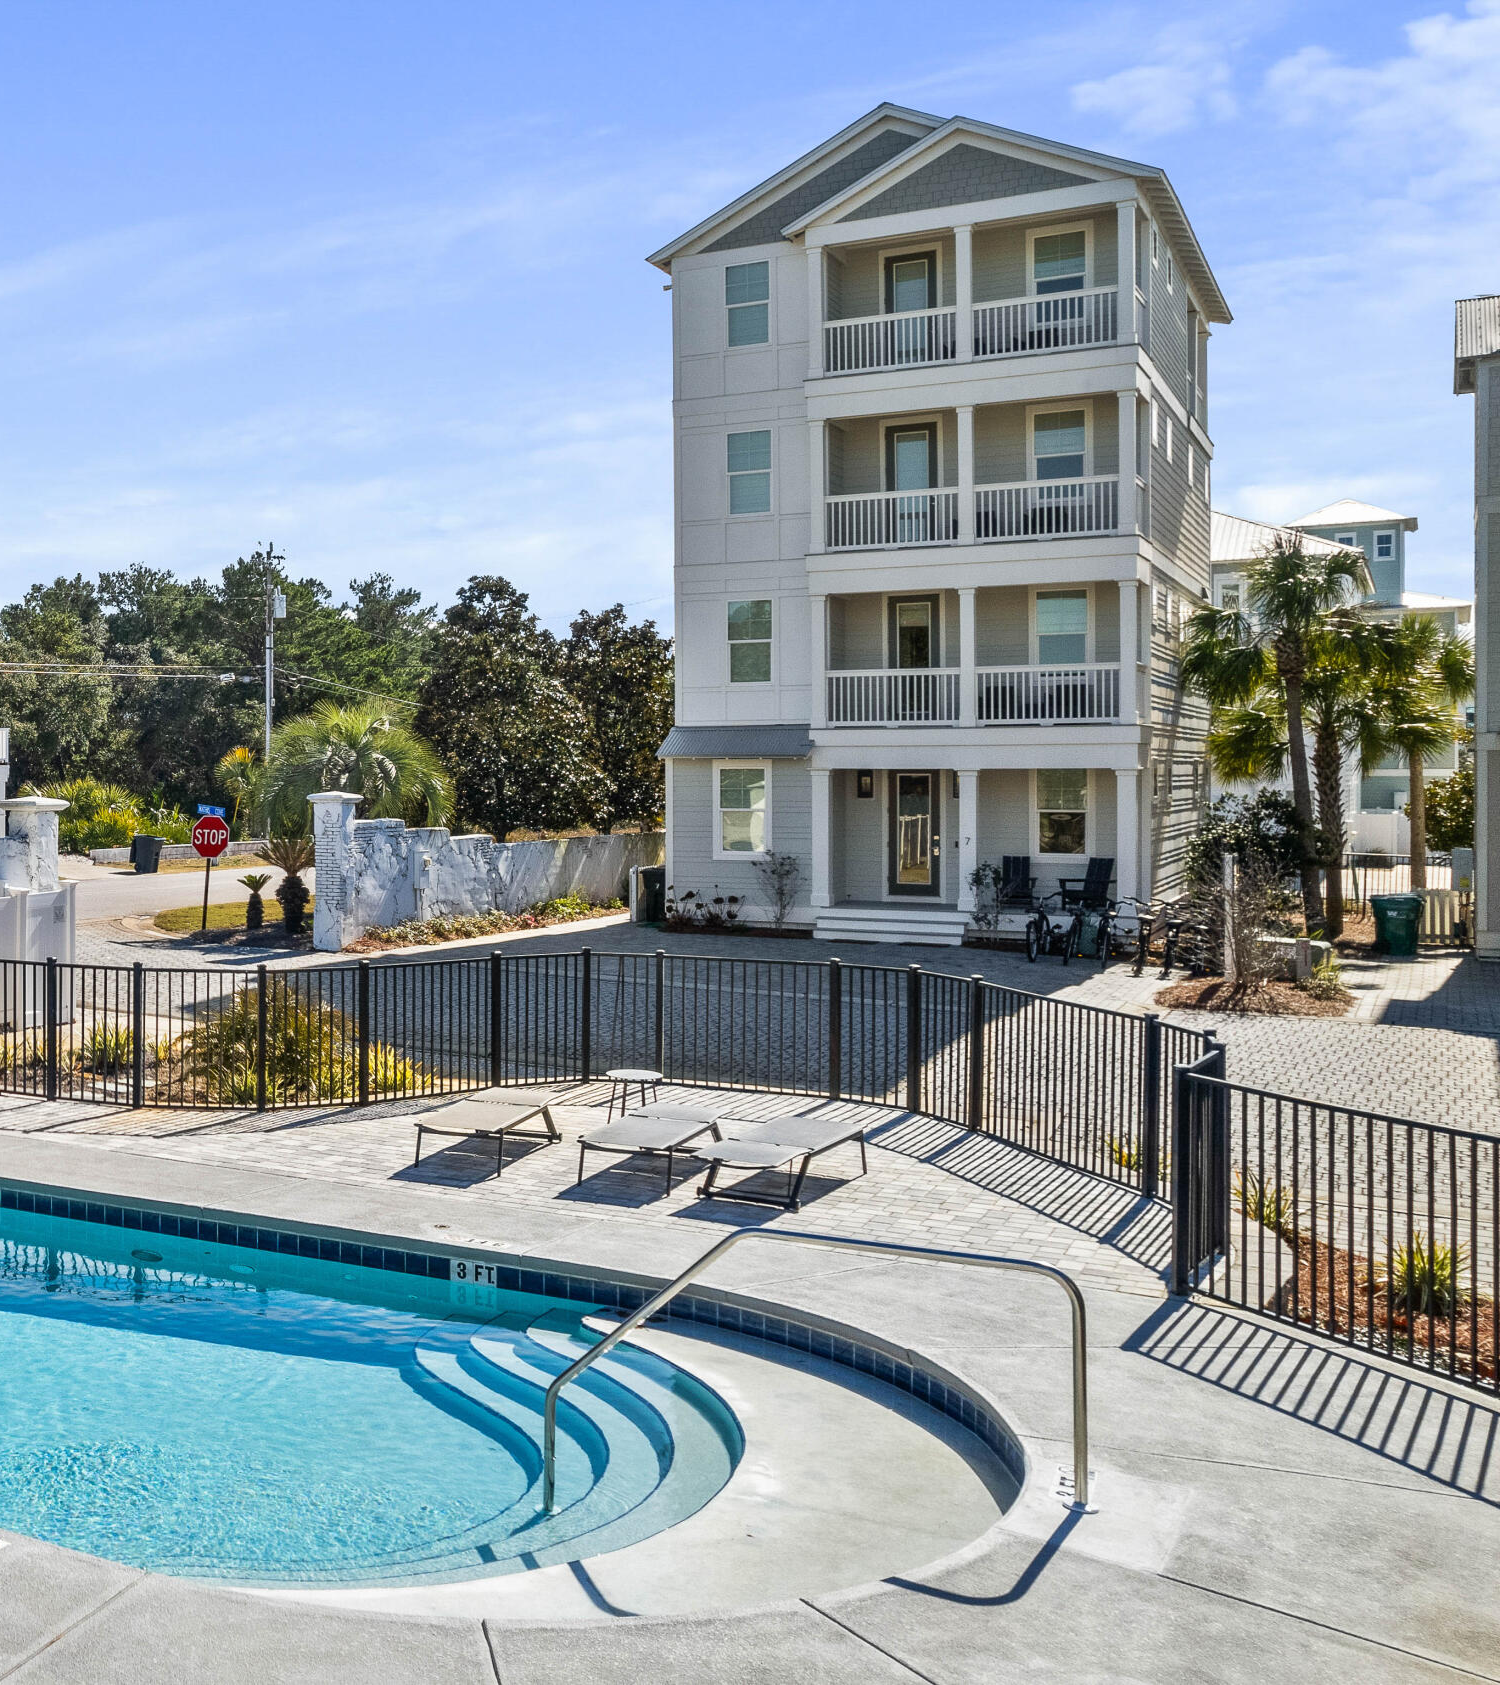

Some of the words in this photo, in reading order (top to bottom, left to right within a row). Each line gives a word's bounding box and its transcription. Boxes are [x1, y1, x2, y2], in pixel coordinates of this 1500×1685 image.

[194, 829, 227, 845] STOP
[964, 836, 971, 846] 7
[457, 1262, 467, 1280] 3
